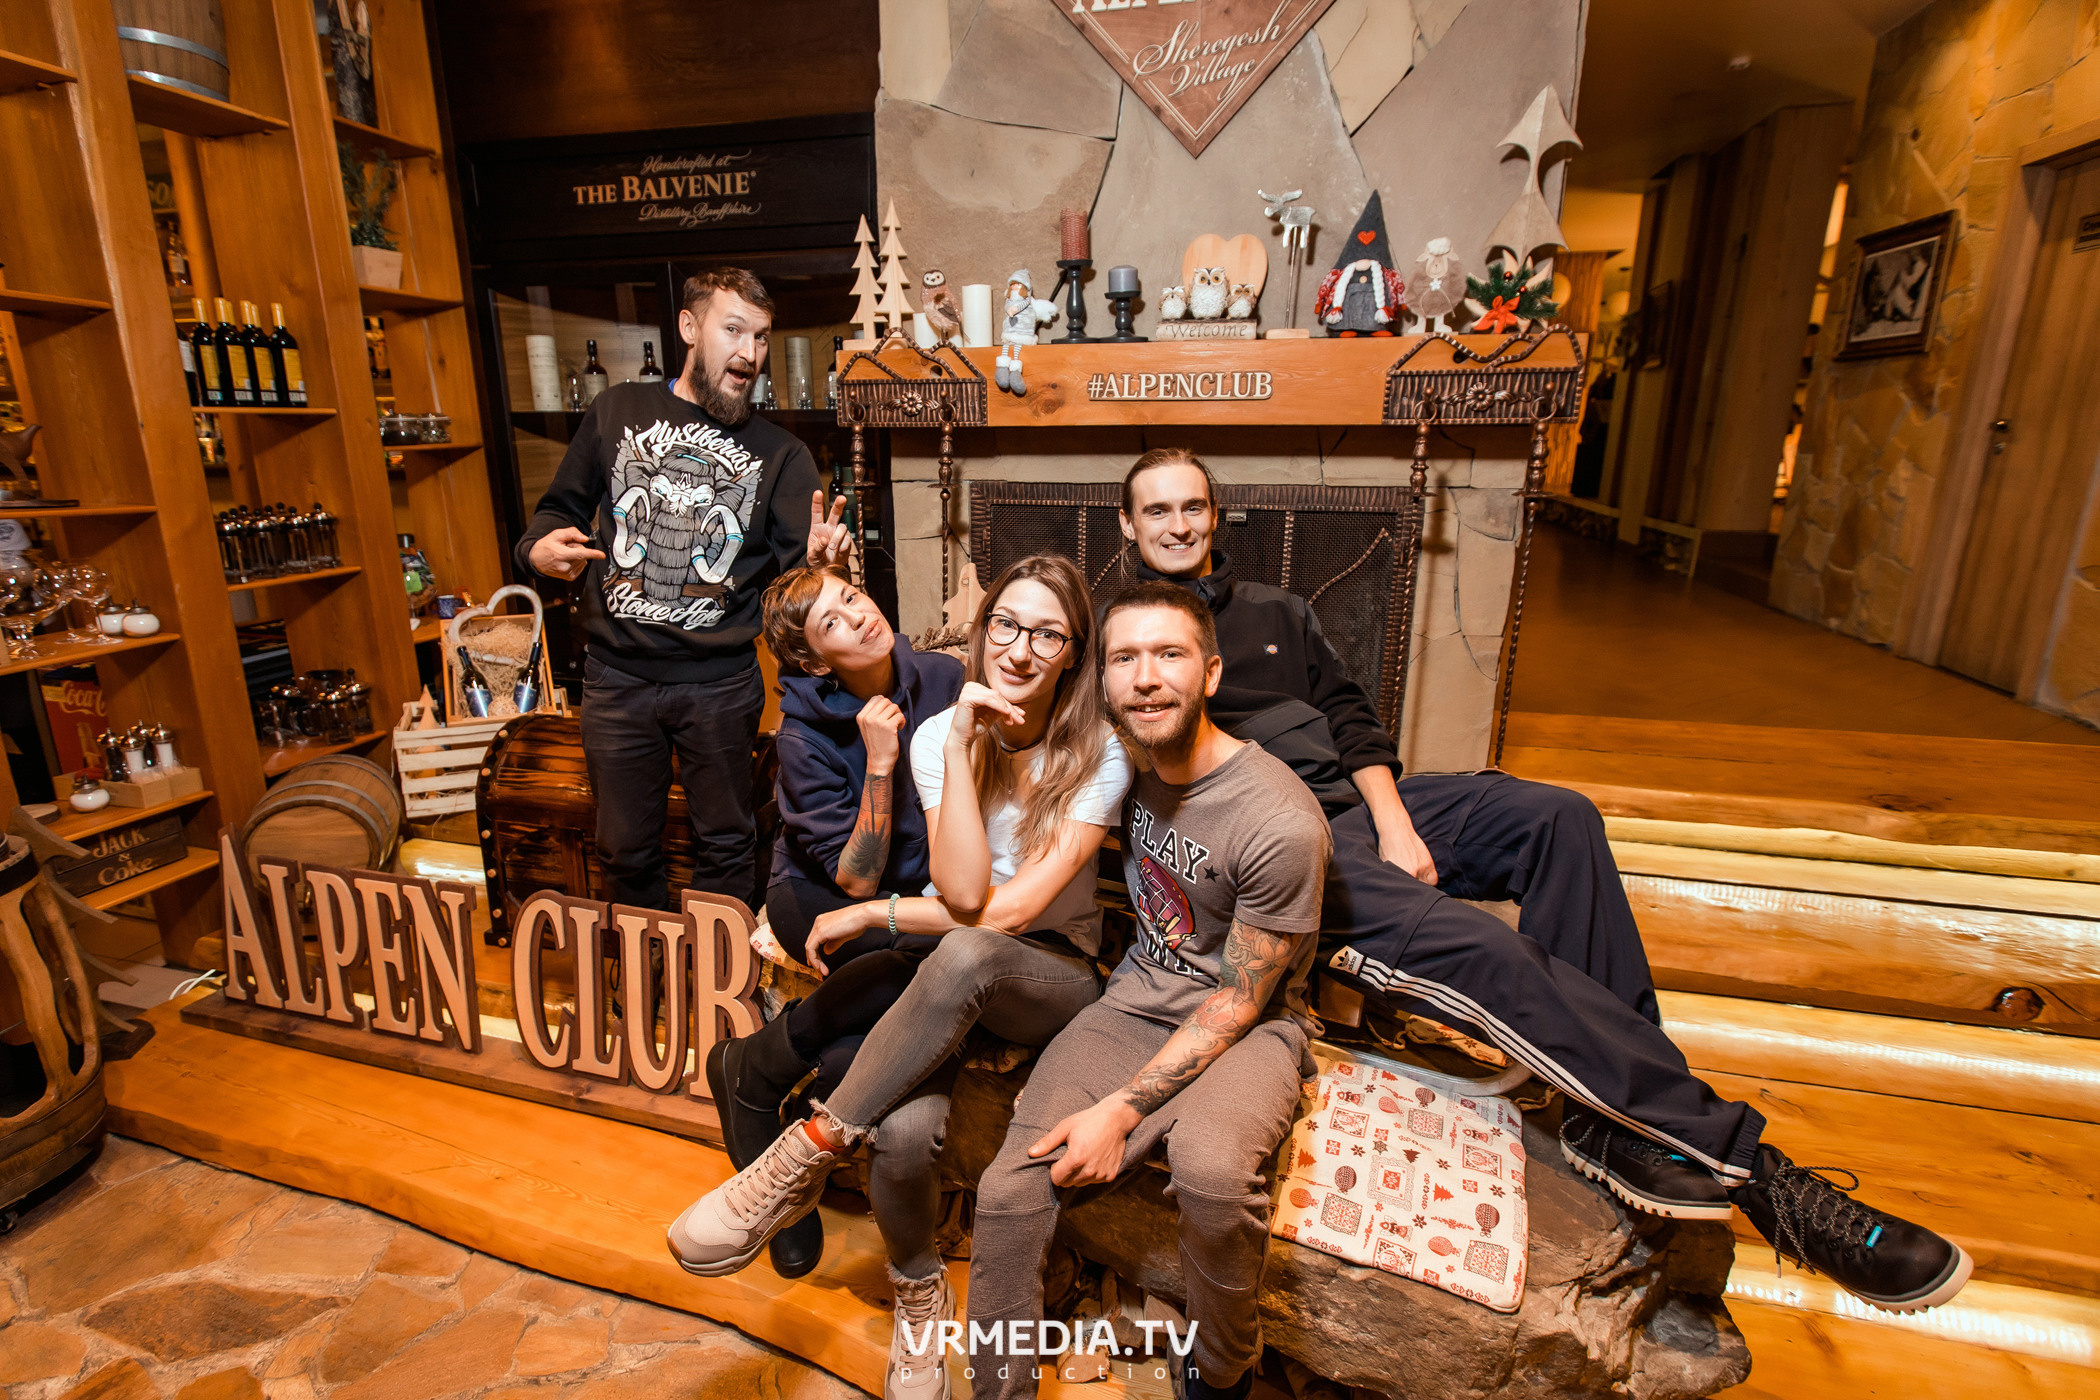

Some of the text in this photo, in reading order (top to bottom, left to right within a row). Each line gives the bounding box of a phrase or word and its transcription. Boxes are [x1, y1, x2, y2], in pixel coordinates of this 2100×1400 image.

[1132, 0, 1287, 83] Sheregesh
[1168, 53, 1256, 101] Village
[640, 149, 751, 175] Handcrafted at
[573, 184, 617, 205] THE
[1165, 324, 1249, 338] Welcome
[1087, 371, 1273, 401] #ALPENCLUB
[635, 419, 751, 471] My Siberia
[606, 582, 725, 631] Stone Age
[92, 828, 146, 858] JACK
[1130, 799, 1210, 885] PLAY
[98, 857, 154, 886] Coke
[118, 853, 130, 862] &
[219, 825, 765, 1100] ALPEN CLUB
